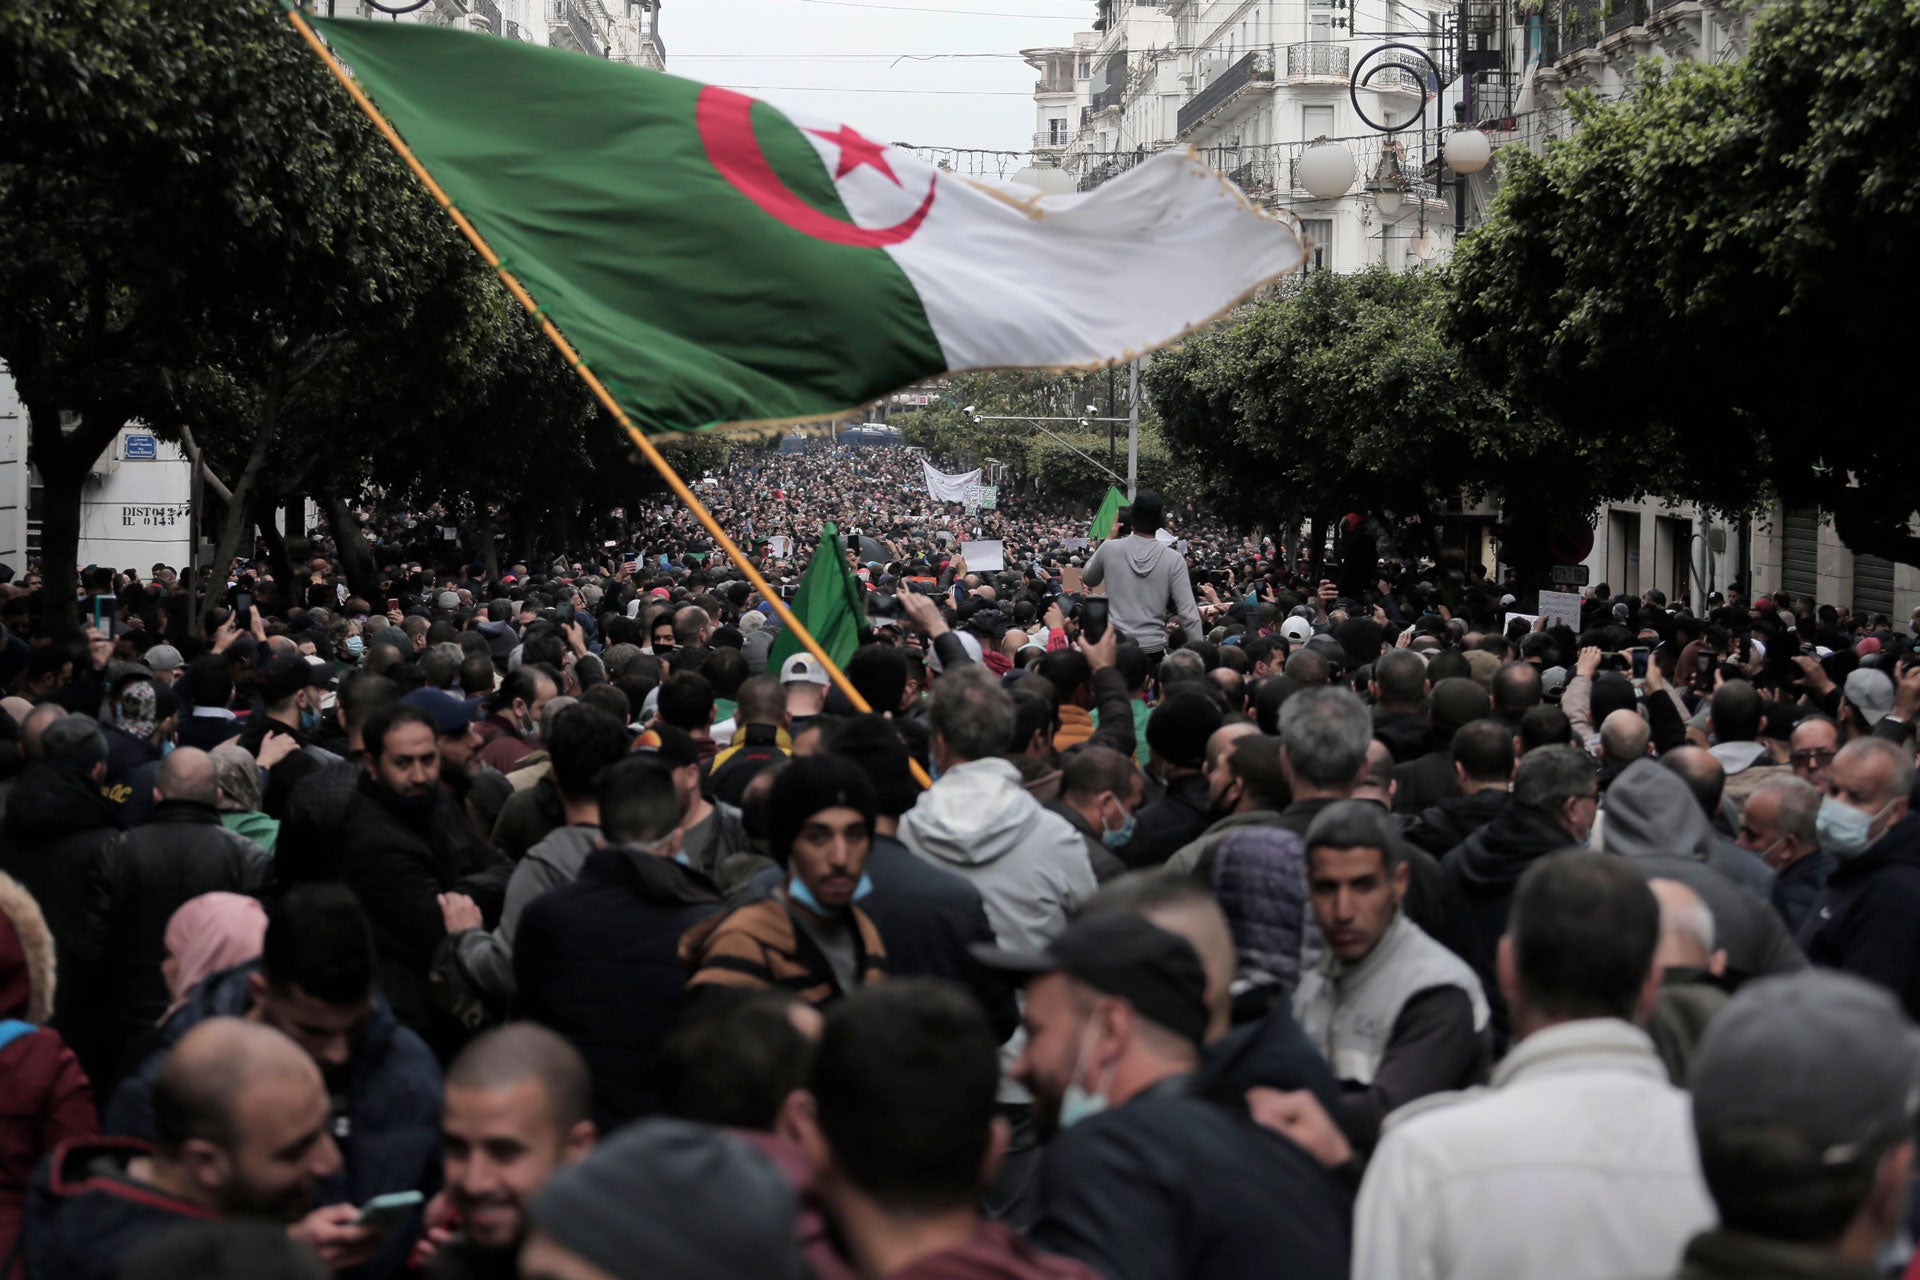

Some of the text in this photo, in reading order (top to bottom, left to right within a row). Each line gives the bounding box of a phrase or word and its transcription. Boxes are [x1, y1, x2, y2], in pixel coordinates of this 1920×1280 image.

[122, 507, 151, 516] DIST
[122, 517, 175, 526] IL 0143
